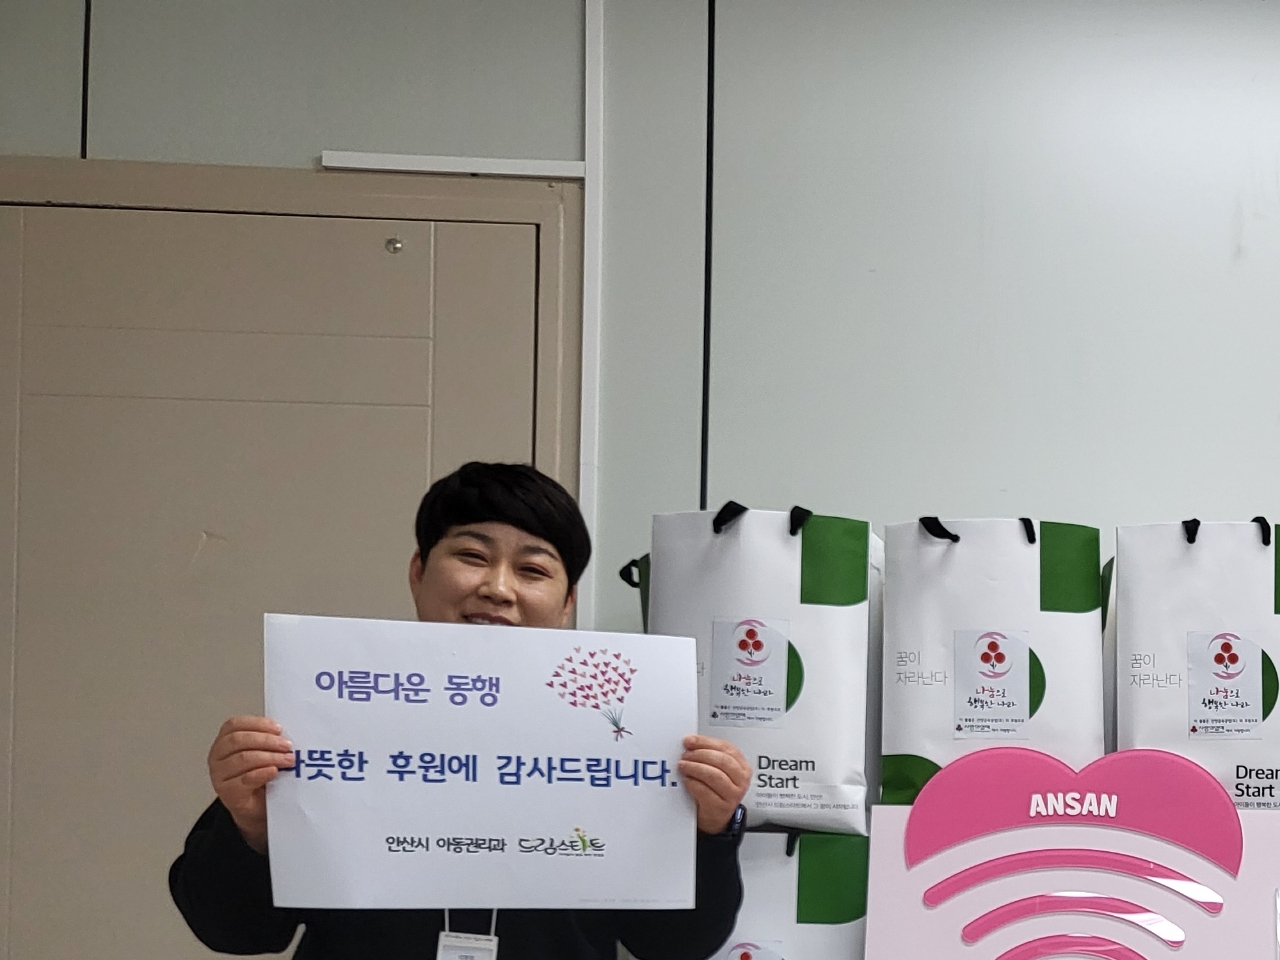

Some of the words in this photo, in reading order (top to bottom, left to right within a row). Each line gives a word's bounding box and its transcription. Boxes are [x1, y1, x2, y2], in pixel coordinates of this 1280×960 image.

[896, 651, 920, 667] 꿈이
[1131, 653, 1155, 669] 꿈이
[896, 670, 948, 686] 자라난다
[1130, 673, 1183, 688] 자라난다
[315, 670, 431, 703] 아름다운
[444, 675, 500, 707] 동행
[387, 751, 478, 783] 후원에
[497, 755, 678, 787] 감사드립니다.
[758, 755, 816, 771] Dream
[757, 773, 800, 789] Start
[1234, 782, 1275, 798] Start
[1030, 792, 1117, 817] ANSAN
[385, 836, 429, 852] 안산시
[436, 837, 507, 853] 아동권리과
